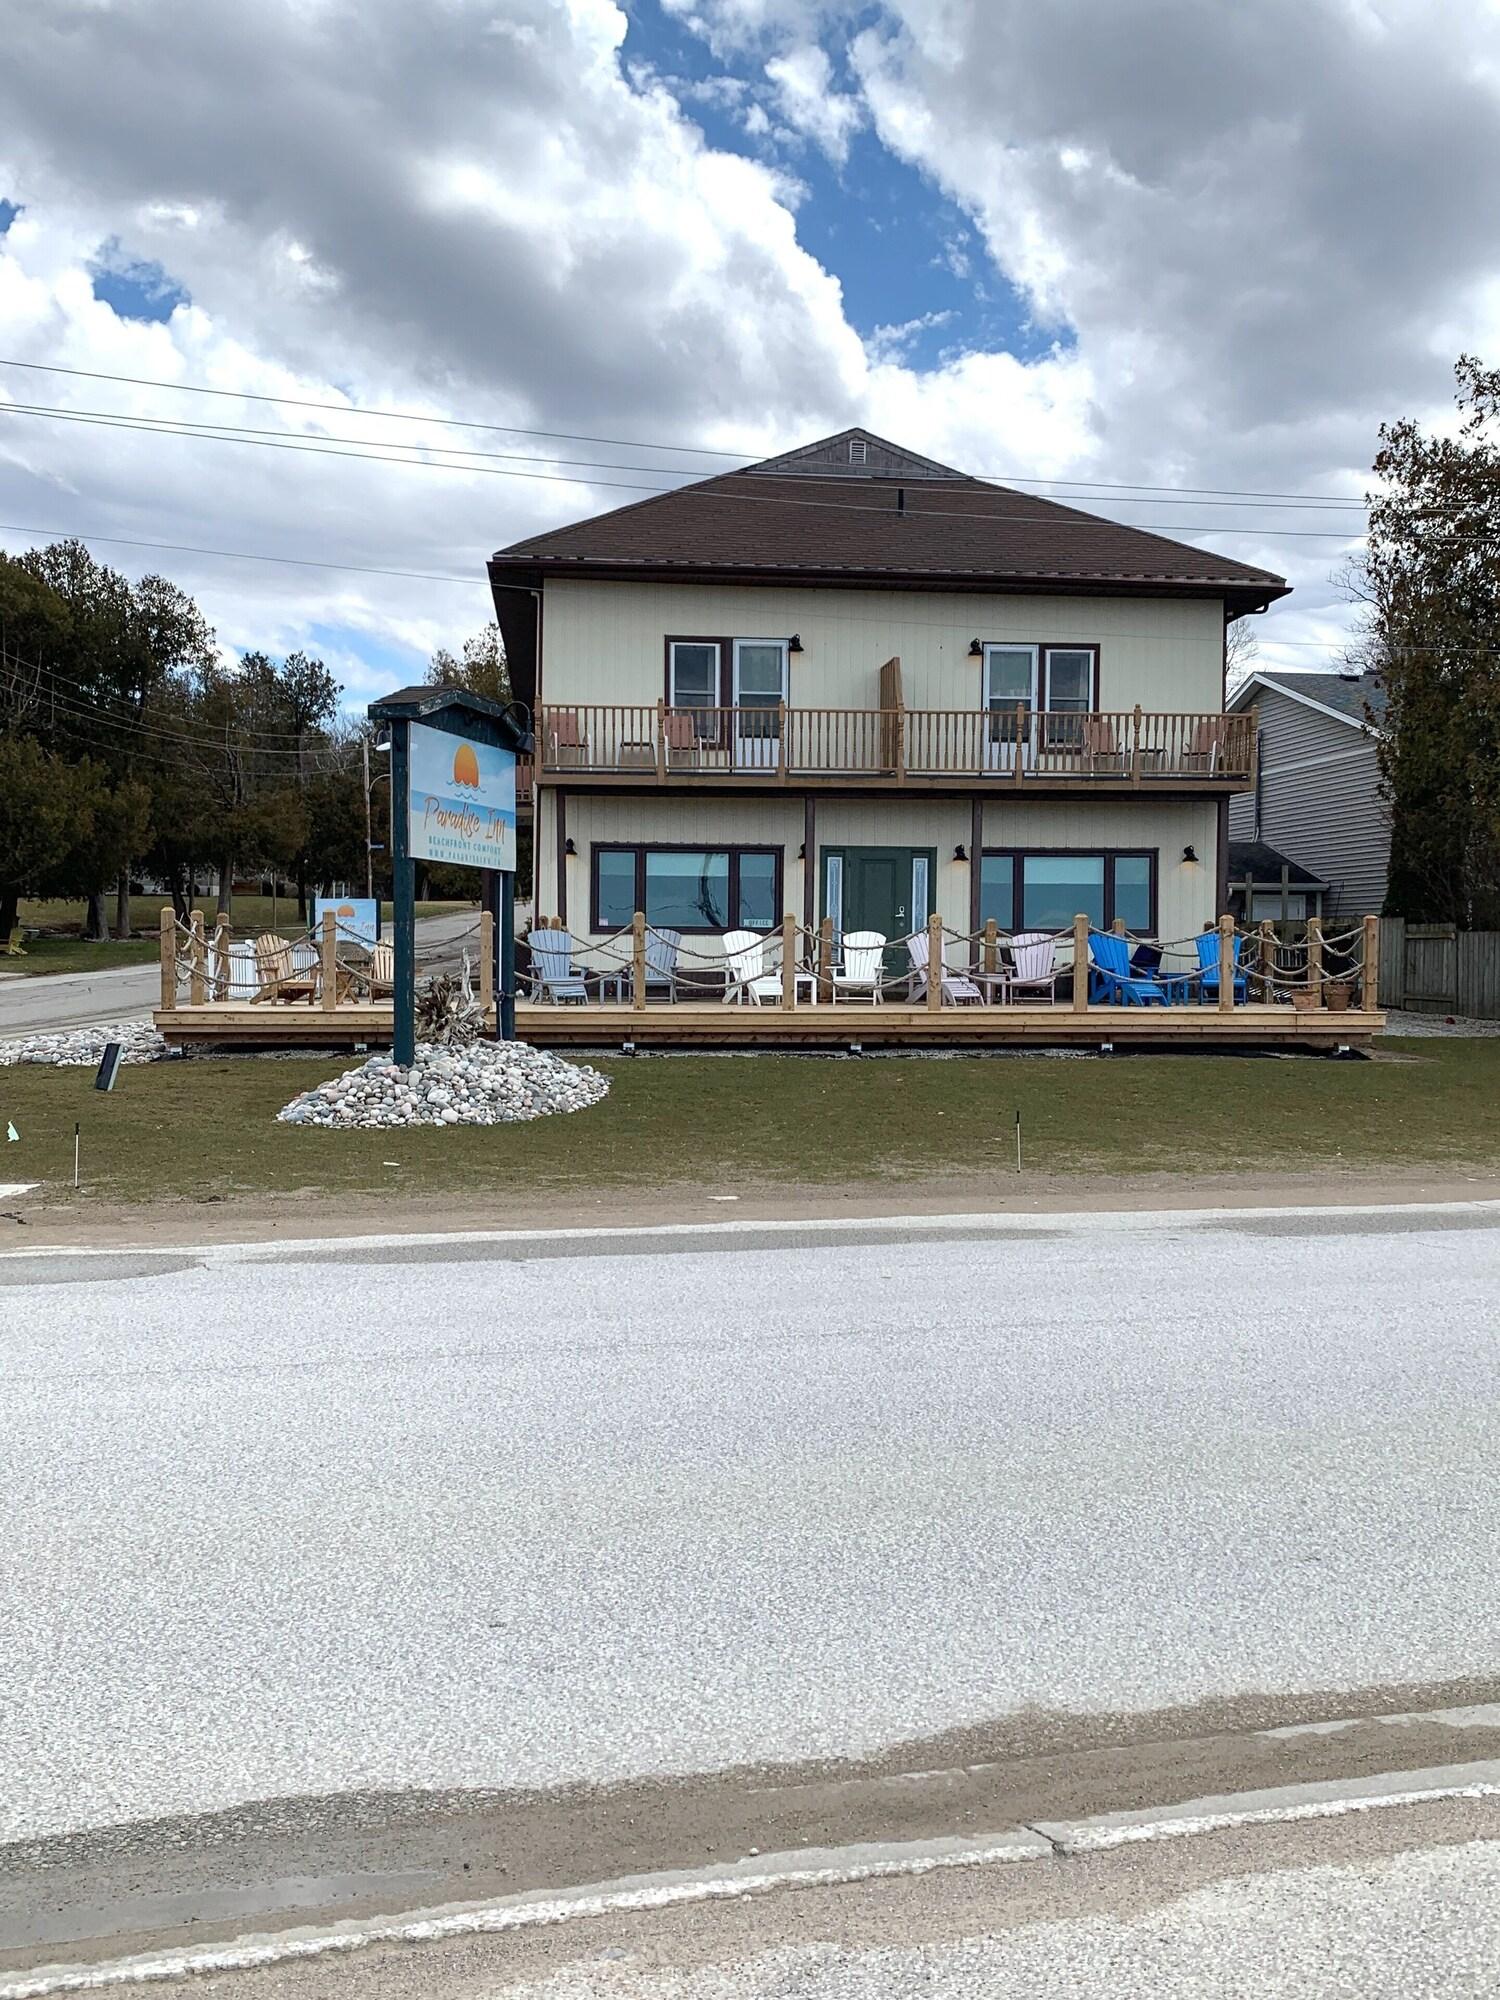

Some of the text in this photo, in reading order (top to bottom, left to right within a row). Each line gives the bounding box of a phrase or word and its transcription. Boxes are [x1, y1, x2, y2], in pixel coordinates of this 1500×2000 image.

[424, 796, 506, 844] Paradise Inn
[428, 835, 501, 855] BEACHFRONT COMFORT
